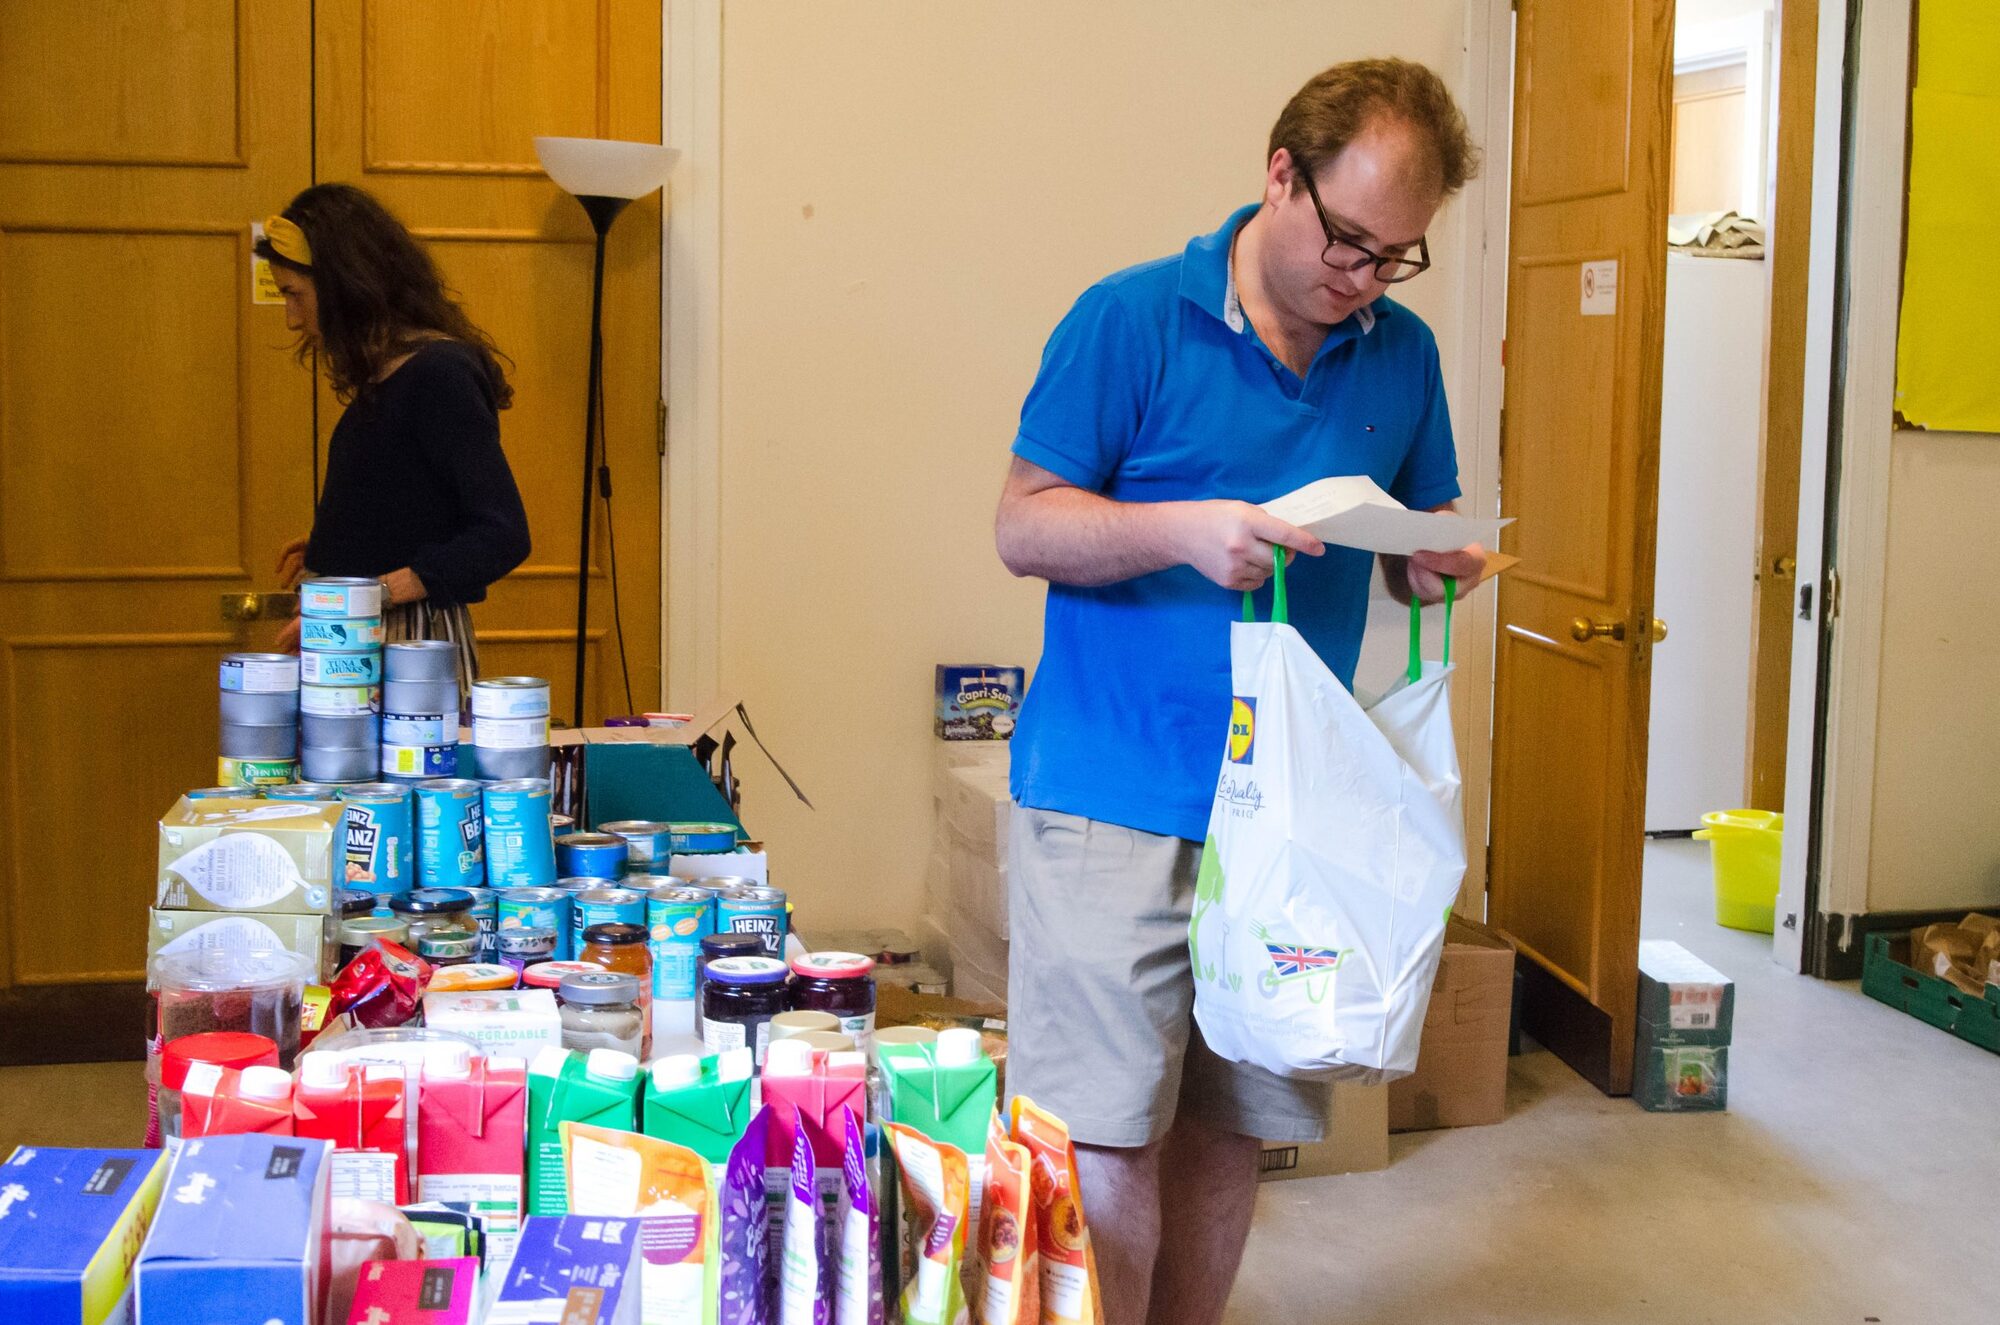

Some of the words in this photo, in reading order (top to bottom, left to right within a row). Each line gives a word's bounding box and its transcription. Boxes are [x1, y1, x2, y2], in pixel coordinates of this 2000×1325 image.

[328, 660, 356, 668] TUNA
[325, 665, 364, 675] CHUNKS
[1232, 724, 1250, 736] DL
[245, 768, 271, 777] JOHN
[272, 767, 291, 776] WEST
[1231, 808, 1254, 819] PRICE
[346, 829, 374, 846] ANZ
[735, 919, 775, 933] HEINZ
